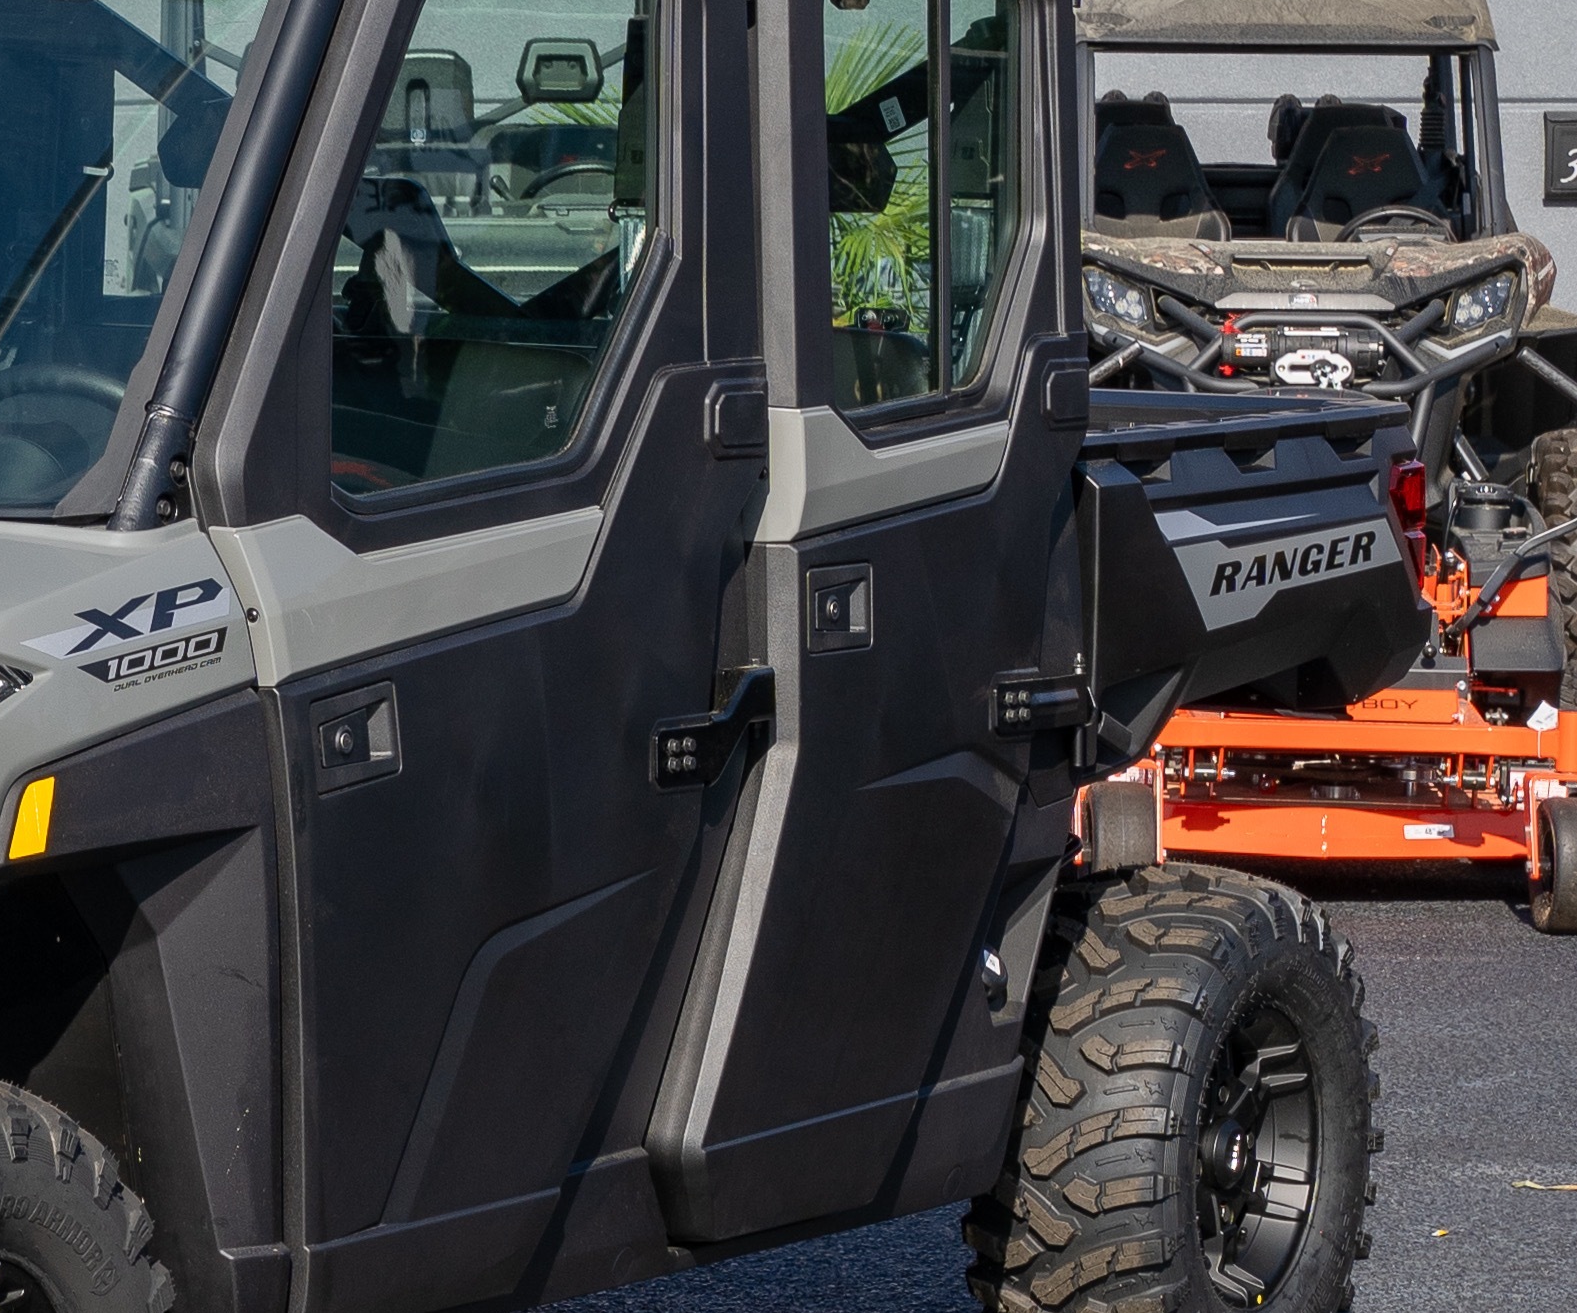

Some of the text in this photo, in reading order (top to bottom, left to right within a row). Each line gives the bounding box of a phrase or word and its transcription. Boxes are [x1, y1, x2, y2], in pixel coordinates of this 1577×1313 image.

[1209, 530, 1376, 597] RANGER
[64, 577, 223, 656] XP
[107, 632, 219, 681] 1000
[114, 656, 222, 693] DUAL OVERHEAD CAM
[1362, 699, 1418, 709] BOY
[28, 1199, 105, 1273] ARMOR
